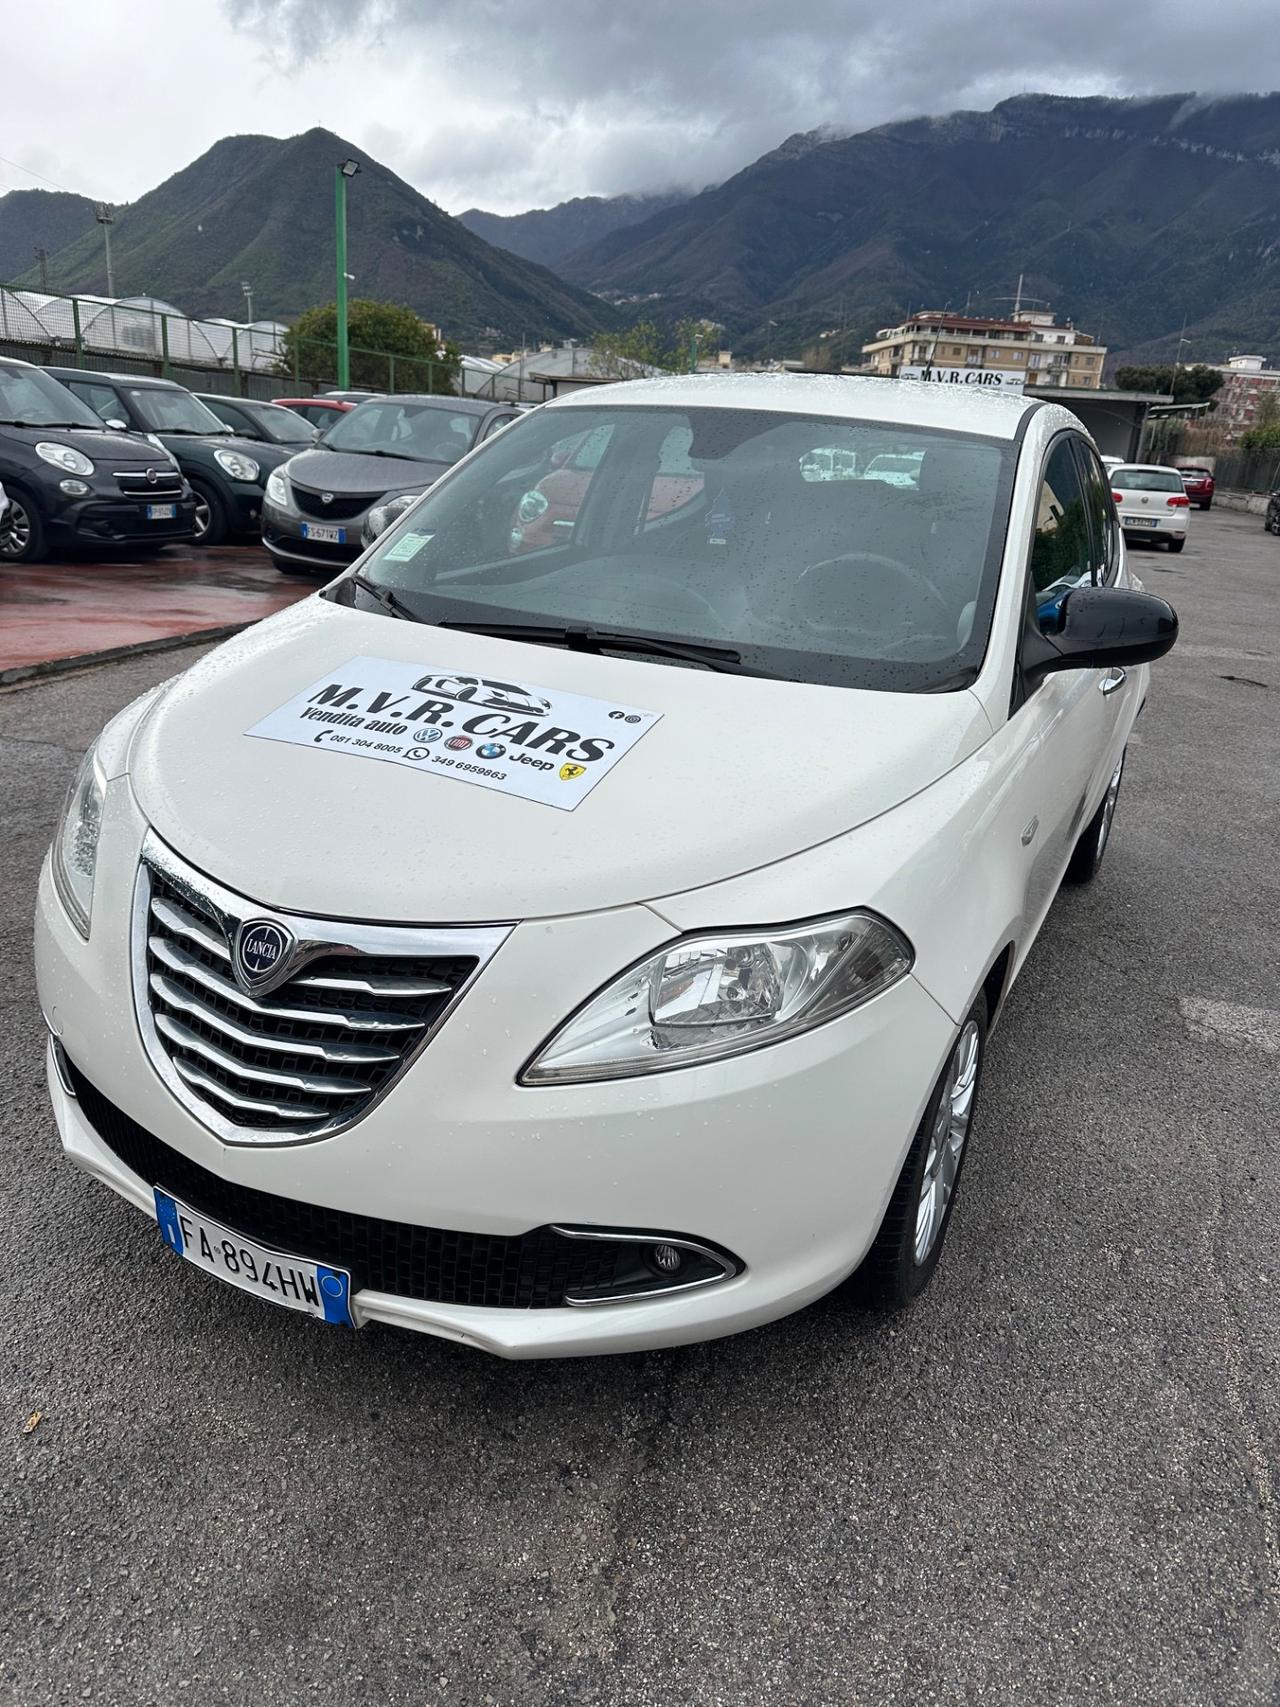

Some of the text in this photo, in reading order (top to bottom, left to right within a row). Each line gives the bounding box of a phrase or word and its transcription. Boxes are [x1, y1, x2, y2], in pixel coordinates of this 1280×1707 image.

[300, 707, 408, 735] Vendita auto
[330, 734, 403, 754] 081 304 8005
[432, 755, 508, 781] 349 6959863
[509, 753, 555, 771] Jeep
[246, 938, 277, 960] LANCIA
